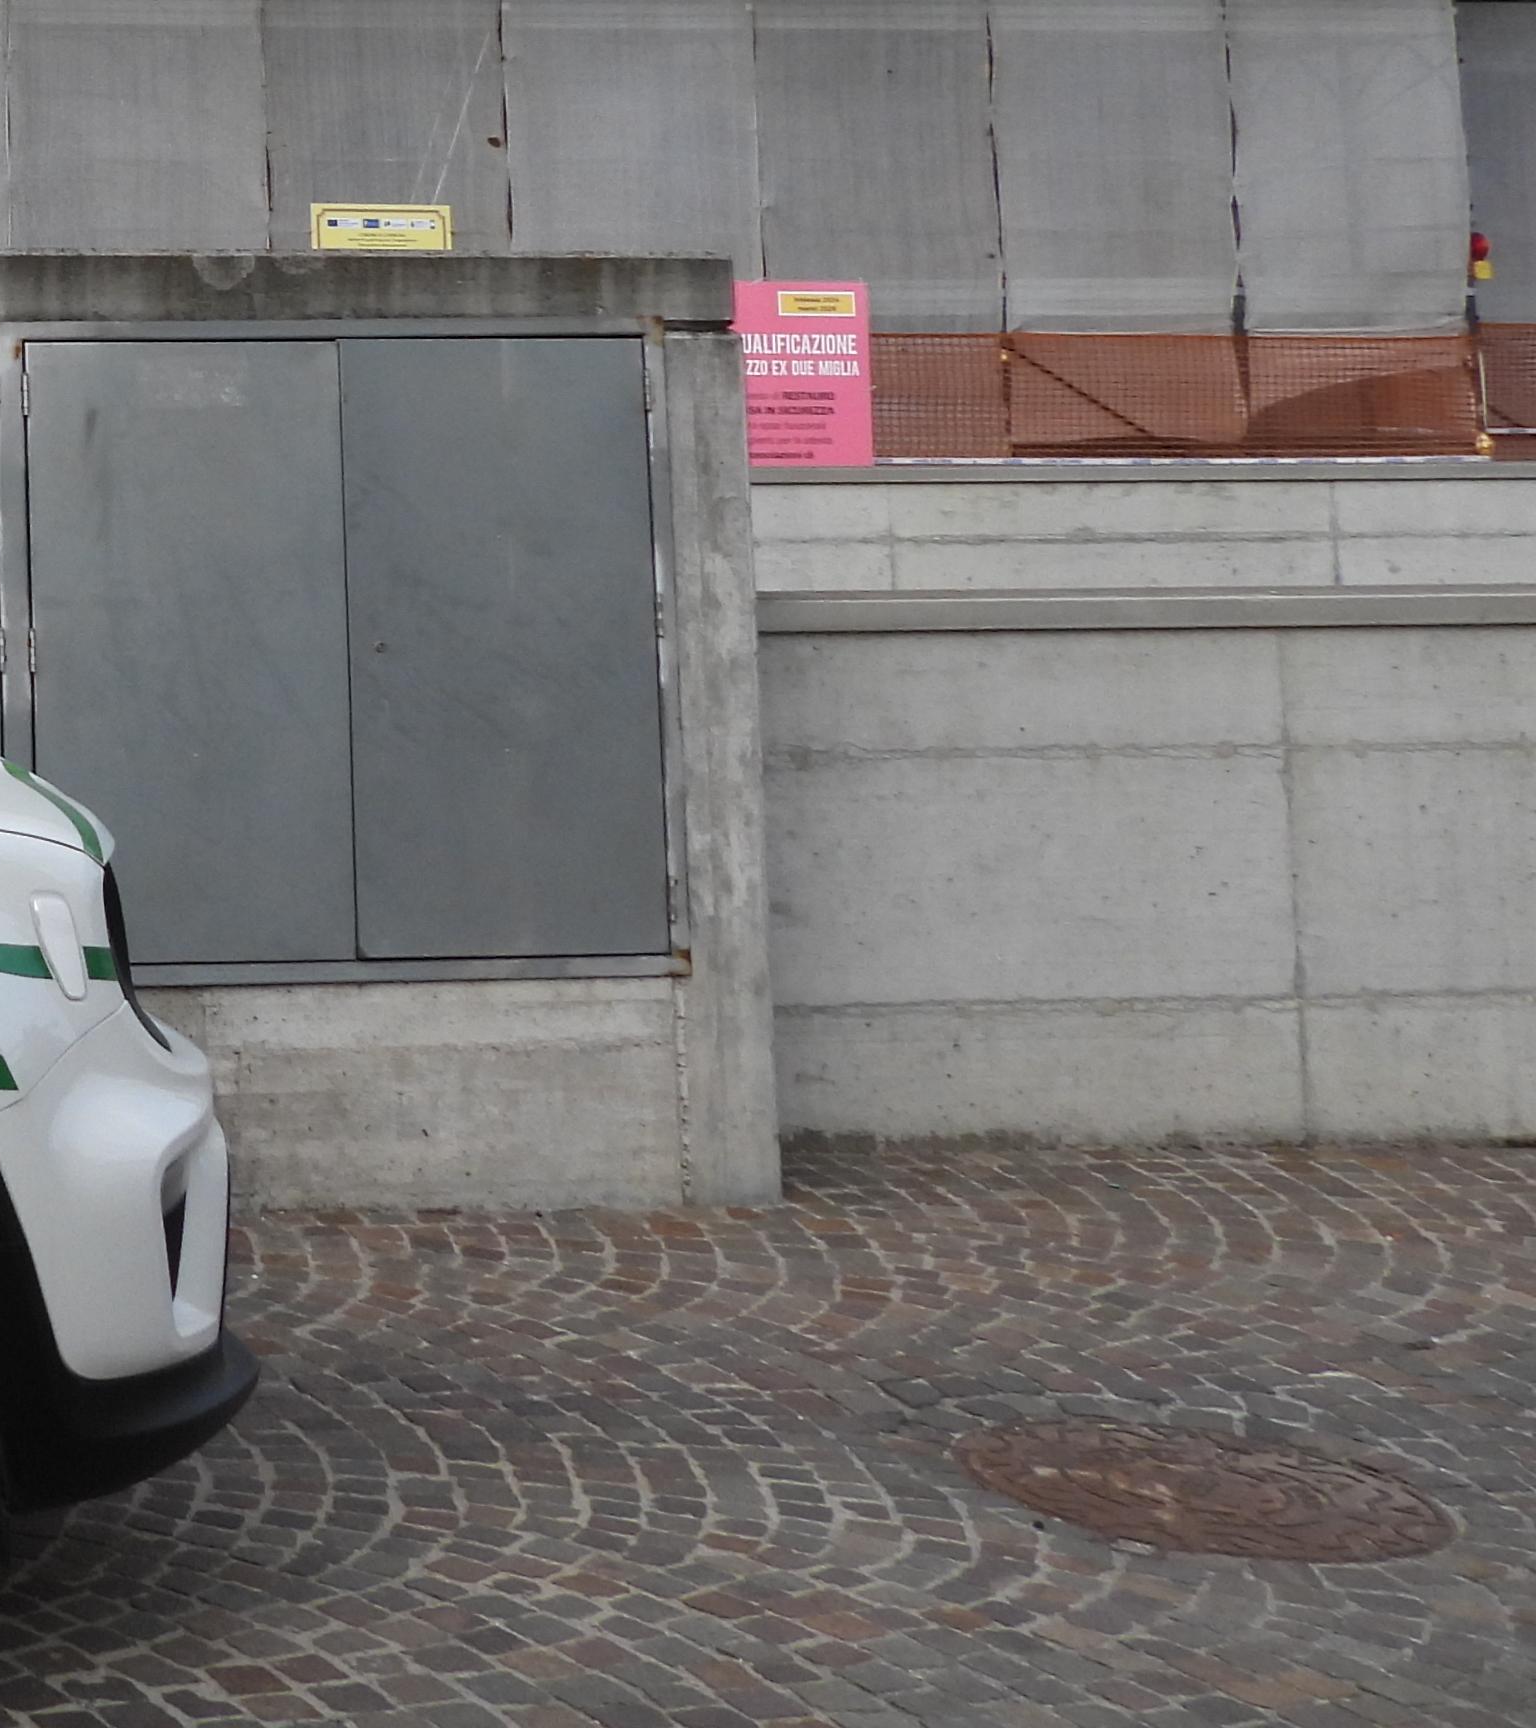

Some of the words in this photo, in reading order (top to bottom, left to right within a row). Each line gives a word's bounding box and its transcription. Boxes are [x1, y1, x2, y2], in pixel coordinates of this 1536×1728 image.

[742, 333, 858, 355] UALIFICAZIONE
[746, 359, 768, 376] ZZO
[772, 359, 788, 376] EX
[791, 359, 814, 376] DUE
[818, 360, 860, 377] MIGLIA
